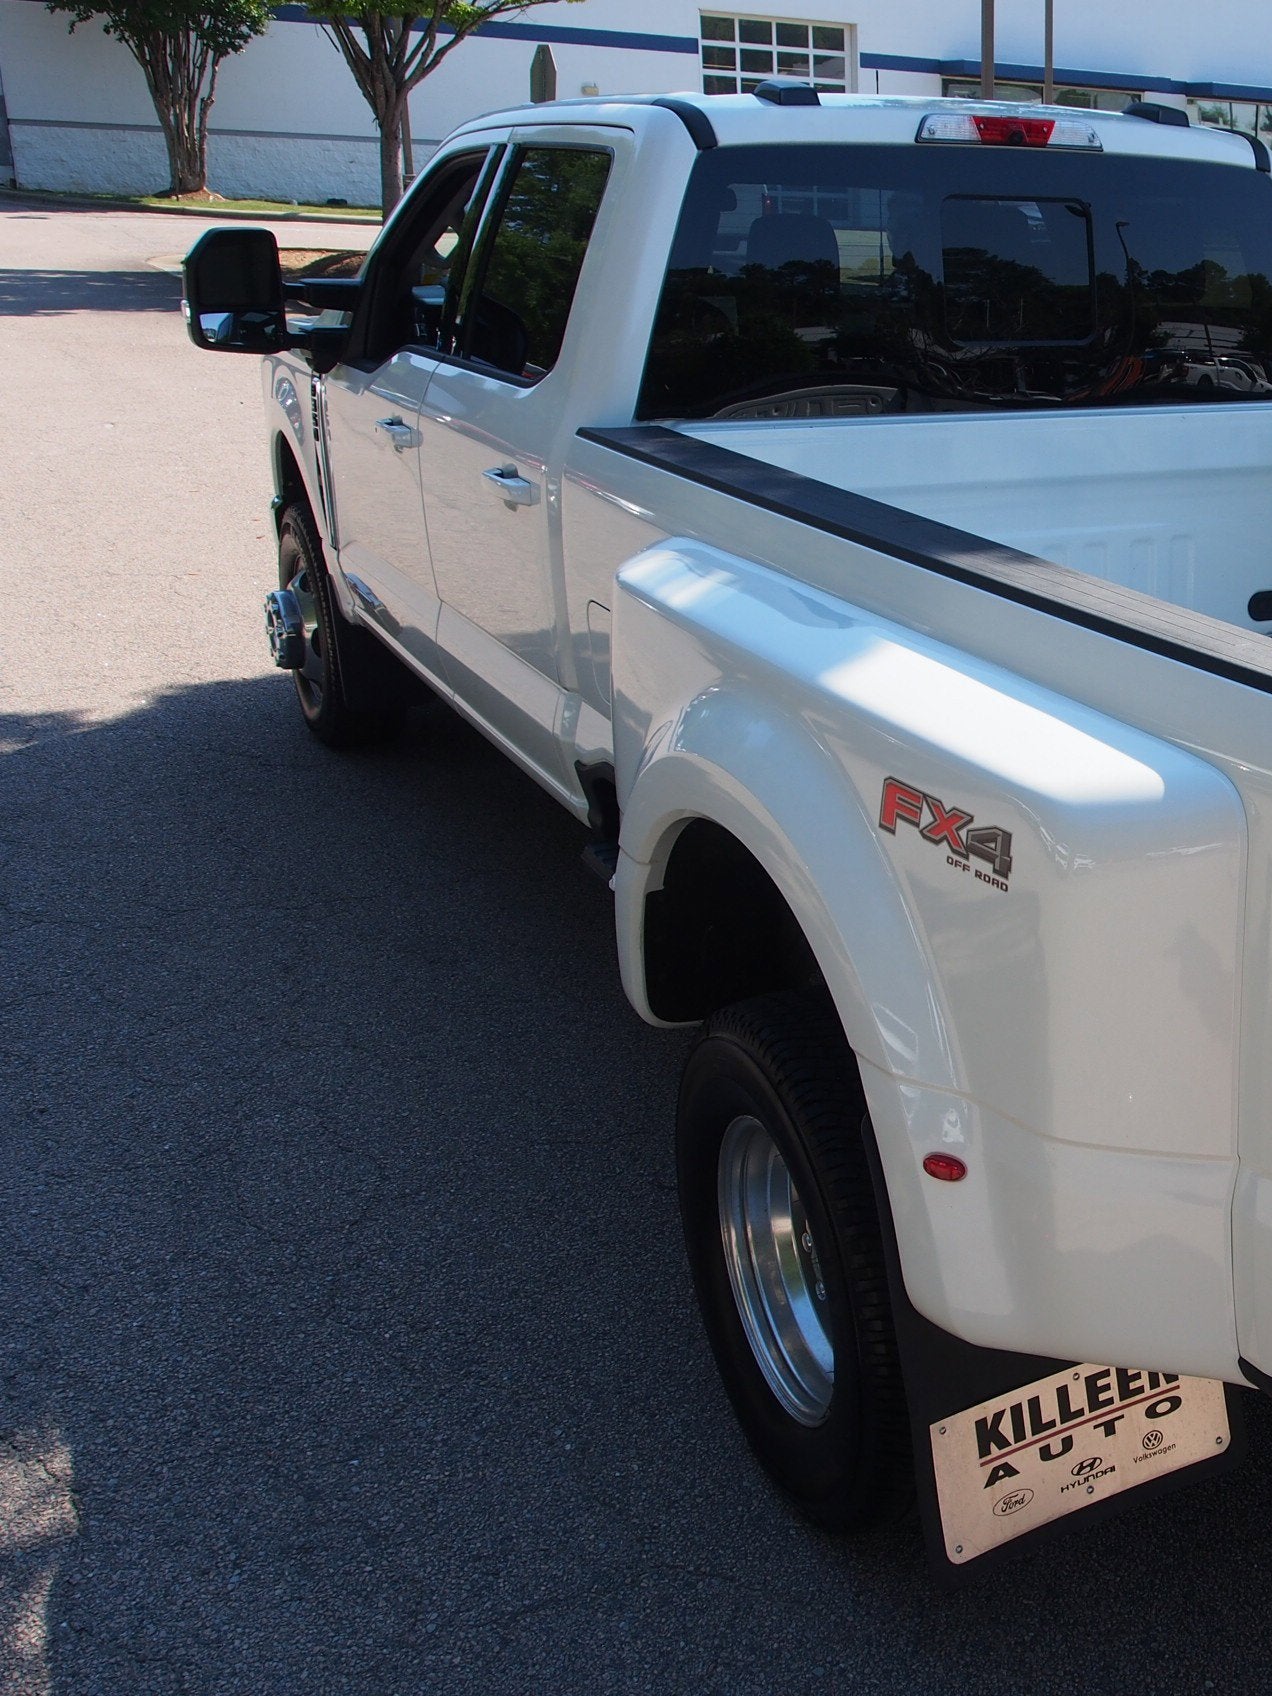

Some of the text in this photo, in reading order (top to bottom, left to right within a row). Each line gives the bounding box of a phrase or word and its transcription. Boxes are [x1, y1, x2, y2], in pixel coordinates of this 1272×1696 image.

[878, 775, 1012, 880] FX4
[946, 855, 1009, 893] OFF ROAD
[983, 1395, 1183, 1490] AUTO
[1132, 1442, 1177, 1465] Volkswagen
[1060, 1464, 1117, 1494] HYUNDAI
[1000, 1492, 1027, 1514] Ford
